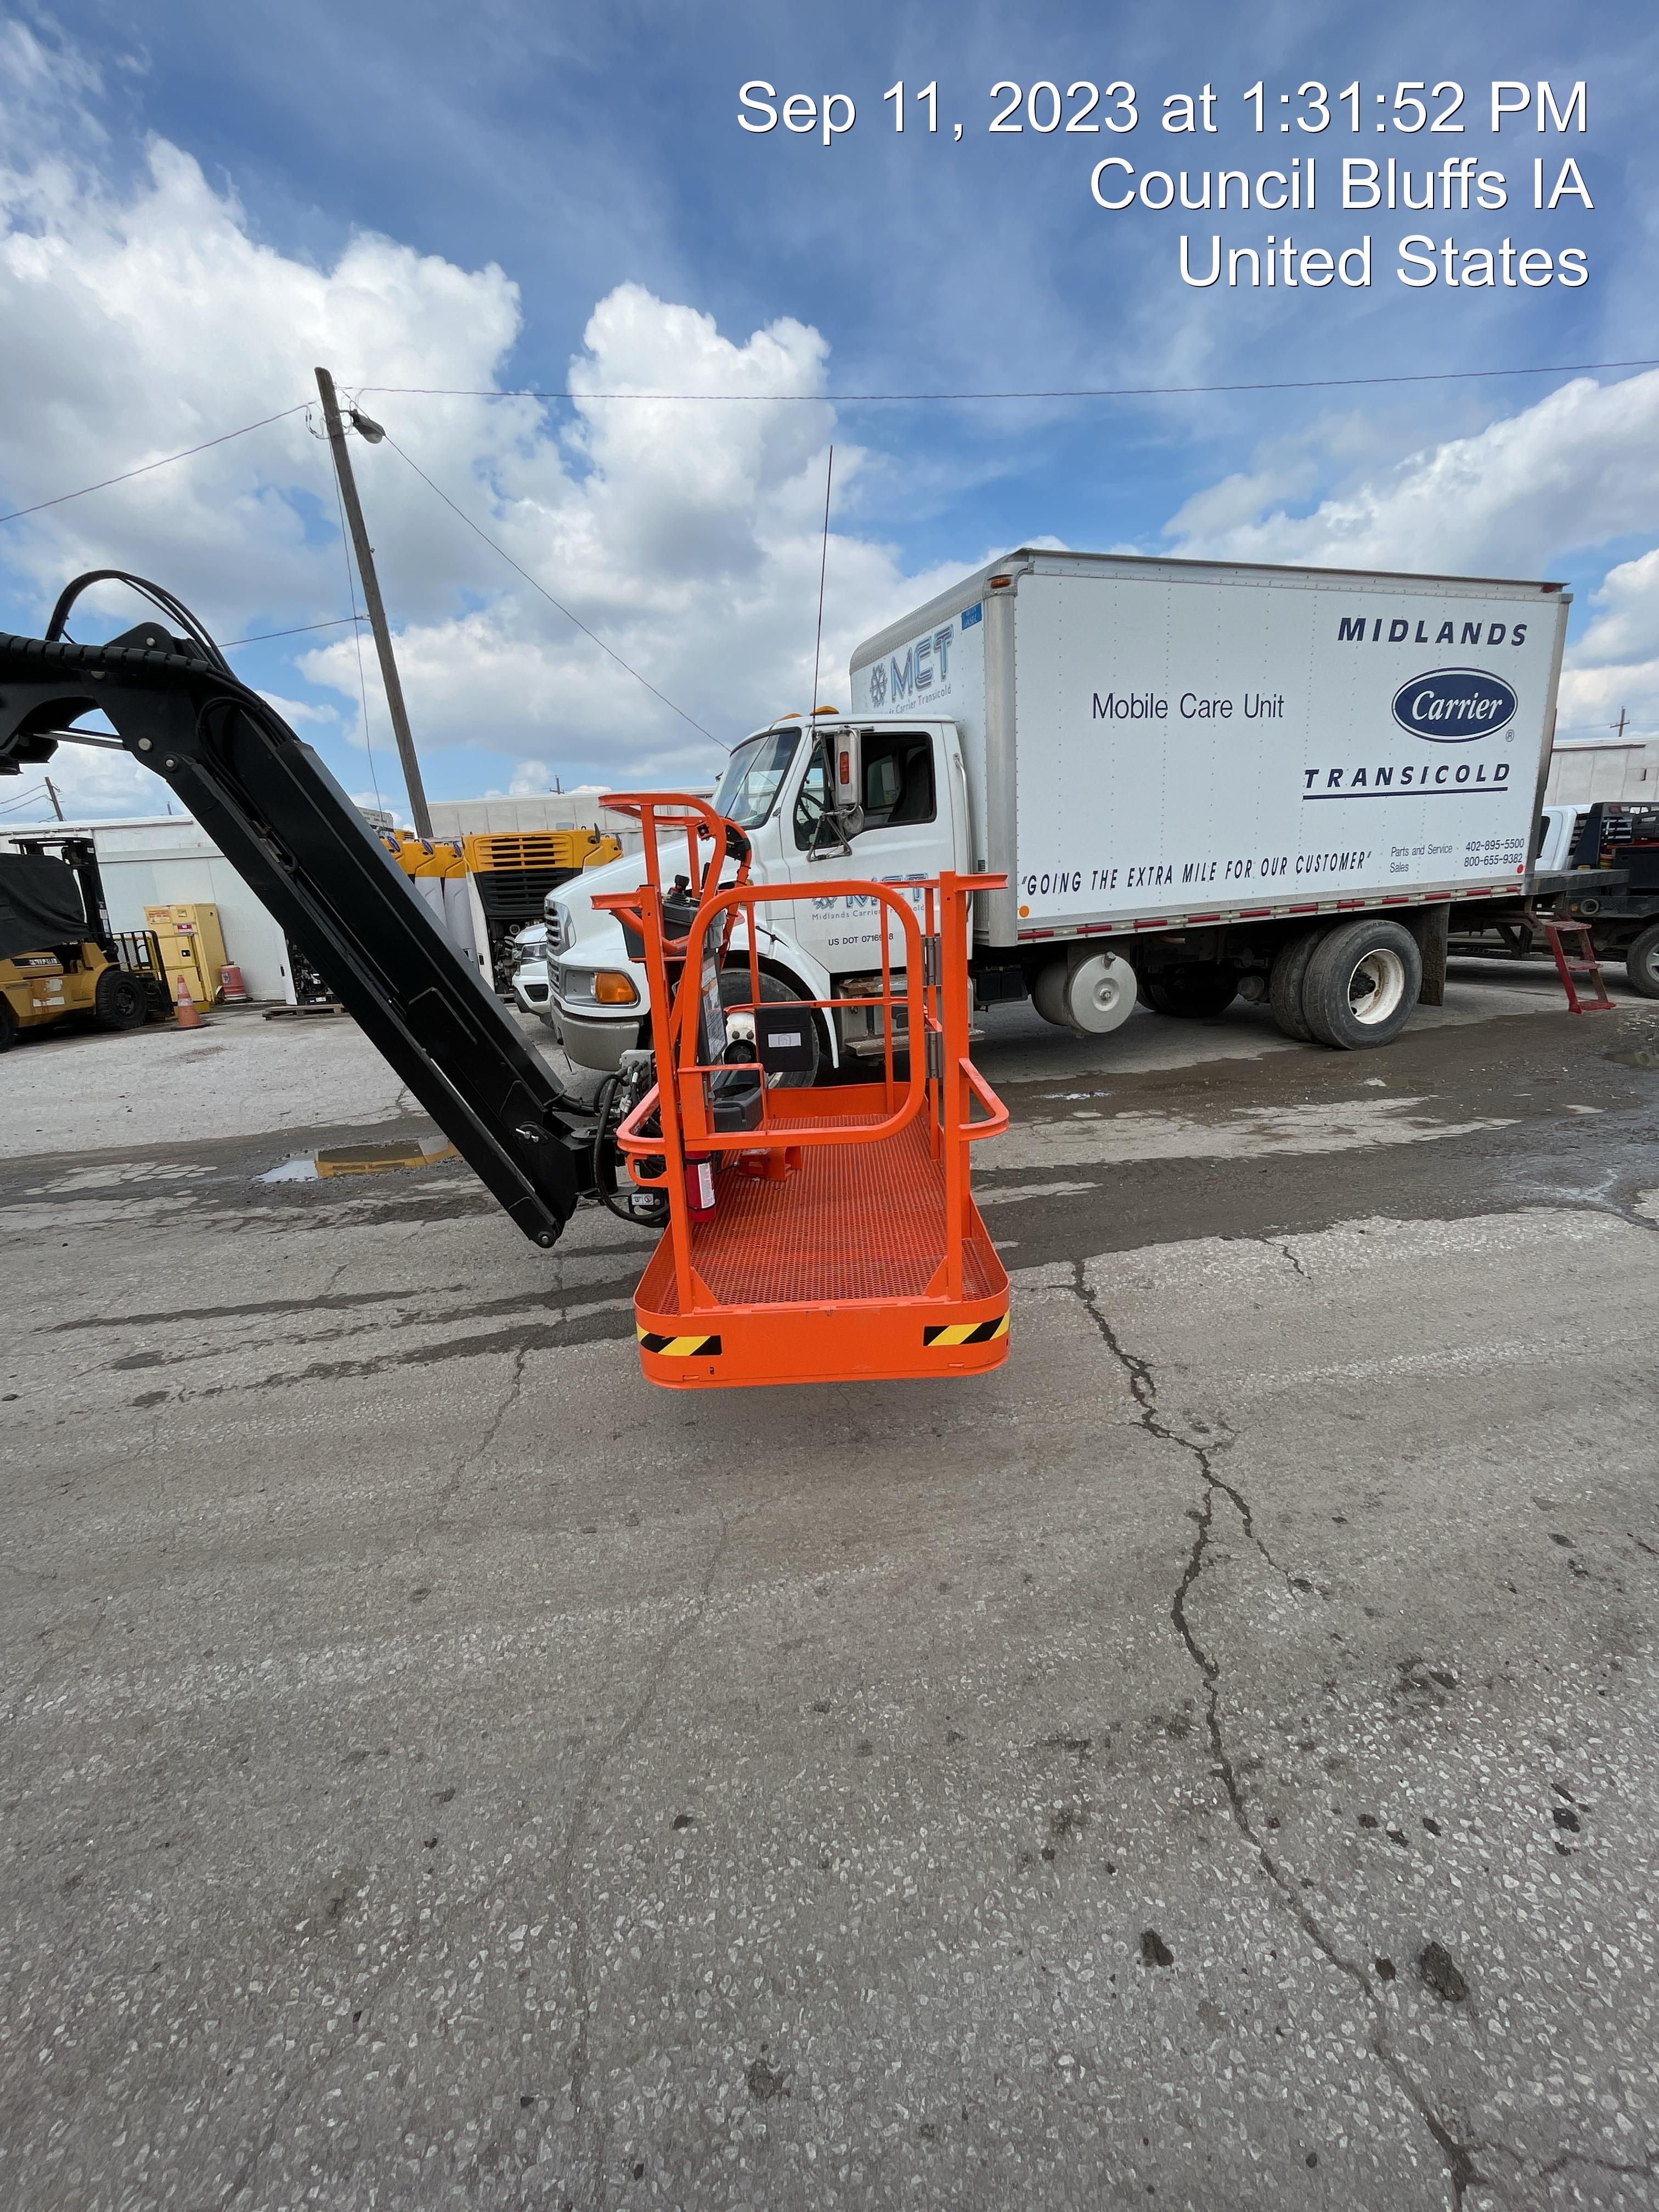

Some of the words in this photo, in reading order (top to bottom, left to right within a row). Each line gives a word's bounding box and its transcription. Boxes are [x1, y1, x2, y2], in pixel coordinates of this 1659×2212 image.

[1338, 617, 1527, 646] MIDLANDS
[890, 624, 954, 703] MCT
[896, 699, 916, 713] Carrier
[918, 683, 951, 706] Transicold
[1093, 692, 1168, 719] Mobile
[1180, 692, 1233, 719] Care
[1244, 693, 1284, 718] Unit
[1412, 690, 1503, 720] Carrier
[1304, 764, 1510, 789] TRANSICOLD
[1391, 847, 1409, 857] Parts
[1412, 845, 1425, 856] and
[1427, 843, 1453, 855] Service
[1465, 838, 1525, 851] 402-895-5500
[1092, 869, 1118, 890] THE
[1127, 865, 1172, 887] EXTRA
[1182, 862, 1217, 883] MILE
[1225, 859, 1252, 879] FOR
[1261, 857, 1288, 877] OUR
[1390, 862, 1409, 873] Sales
[1464, 853, 1523, 867] 800-655-9382
[812, 912, 849, 921] Midlands
[861, 933, 894, 943] 07168
